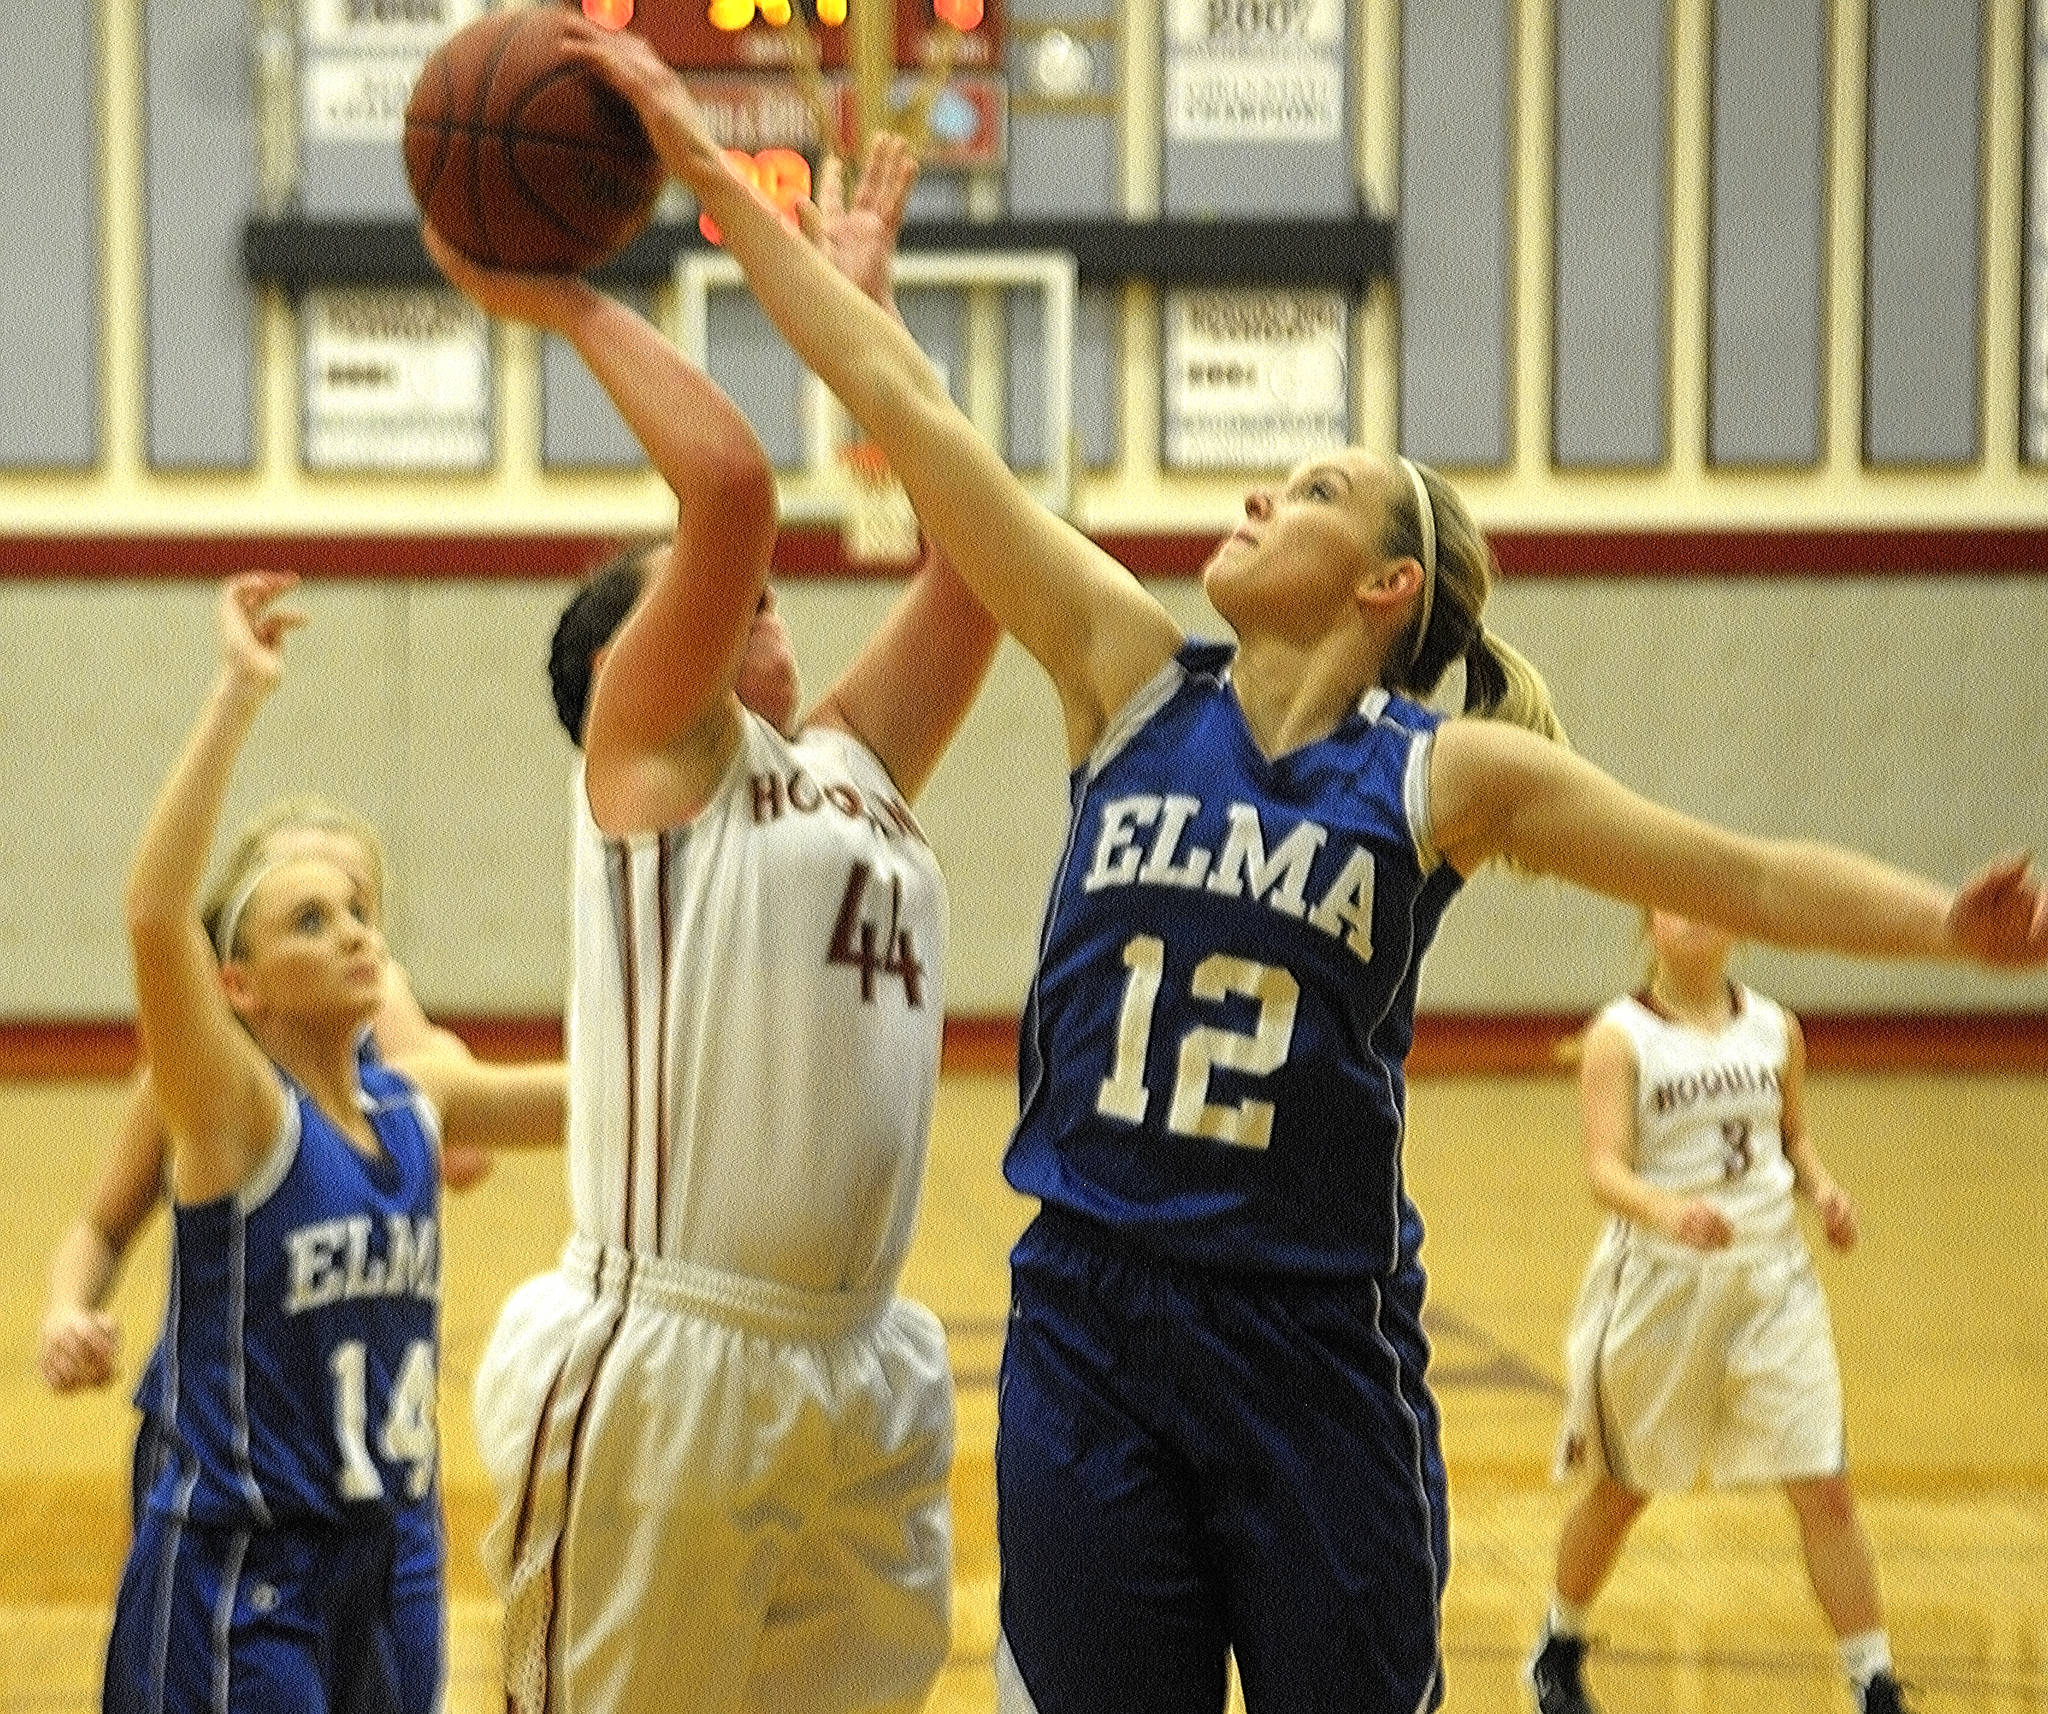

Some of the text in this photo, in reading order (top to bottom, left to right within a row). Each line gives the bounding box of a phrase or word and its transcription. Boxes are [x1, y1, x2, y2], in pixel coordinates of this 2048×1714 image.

[826, 860, 923, 1008] 44
[1085, 795, 1376, 964] ELMA
[1097, 933, 1300, 1150] 12
[1722, 1119, 1750, 1180] 3
[332, 1338, 437, 1500] 14
